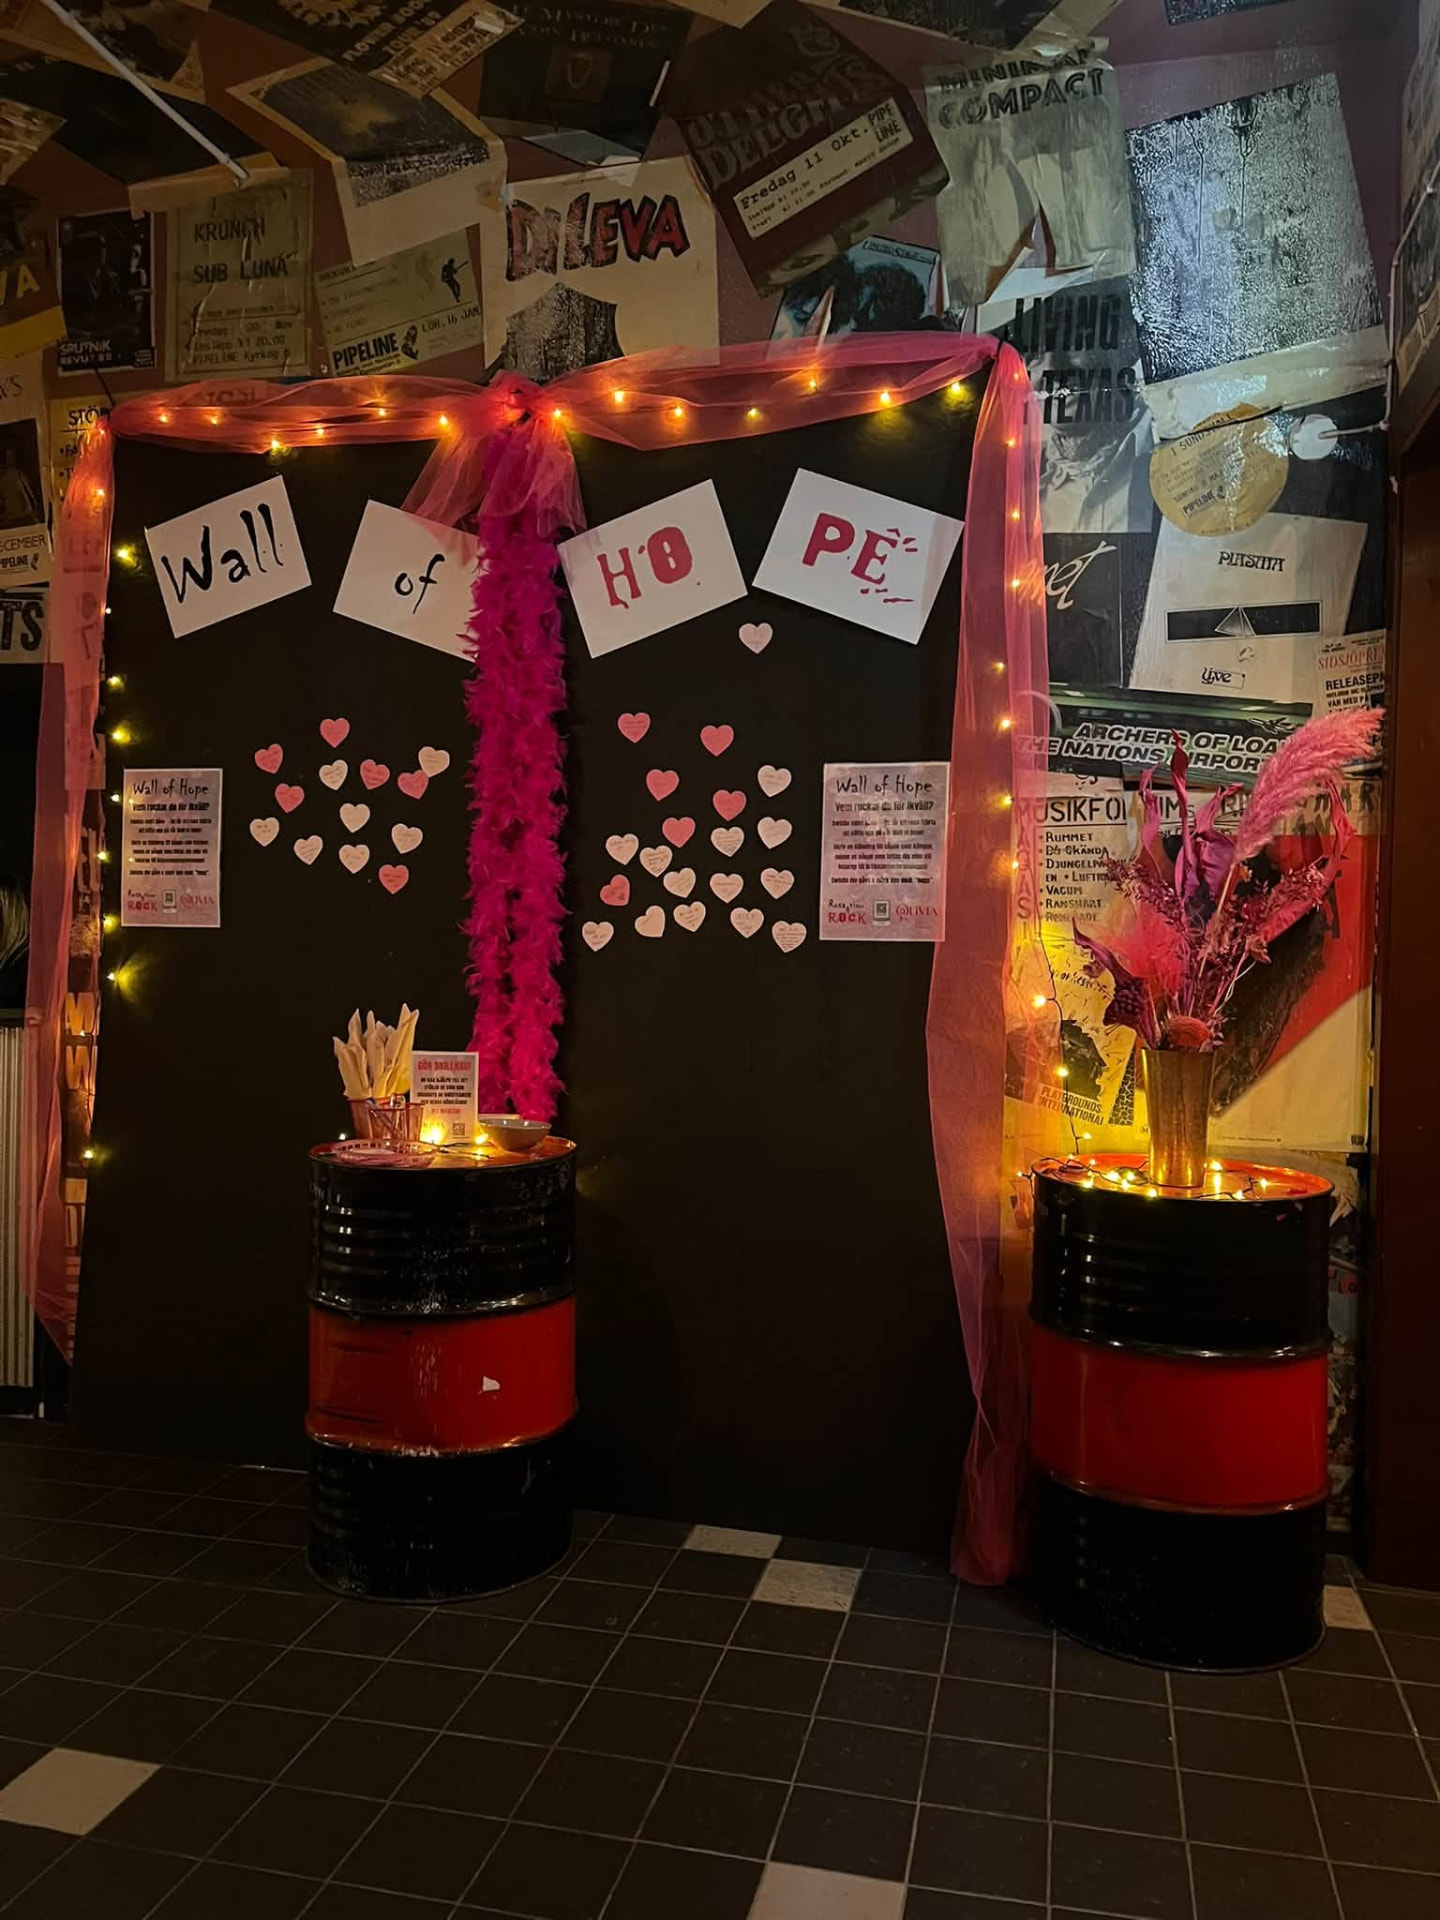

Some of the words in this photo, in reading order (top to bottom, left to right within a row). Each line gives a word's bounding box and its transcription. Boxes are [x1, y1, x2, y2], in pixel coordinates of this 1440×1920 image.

[939, 68, 1104, 130] COMPACT
[740, 169, 797, 210] Fredag
[804, 151, 824, 170] 11
[830, 128, 869, 151] Okt.
[194, 263, 228, 284] SUB
[240, 256, 289, 280] LUNA
[331, 331, 401, 371] PIPELINE
[161, 502, 287, 605] Wall
[394, 552, 446, 614] of
[1062, 739, 1167, 765] NATIONS
[1073, 722, 1190, 748] ARCHERS
[1193, 731, 1231, 750] OF
[1230, 735, 1286, 755] LOA
[133, 778, 158, 795] Wall
[163, 778, 175, 797] of
[180, 778, 209, 799] Hope
[836, 775, 868, 794] Wall
[874, 774, 889, 796] of
[896, 774, 933, 798] Hope
[1046, 831, 1093, 842] RUMMET
[828, 912, 867, 924] ROCK
[1041, 1086, 1103, 1113] PLAYGROUNDS
